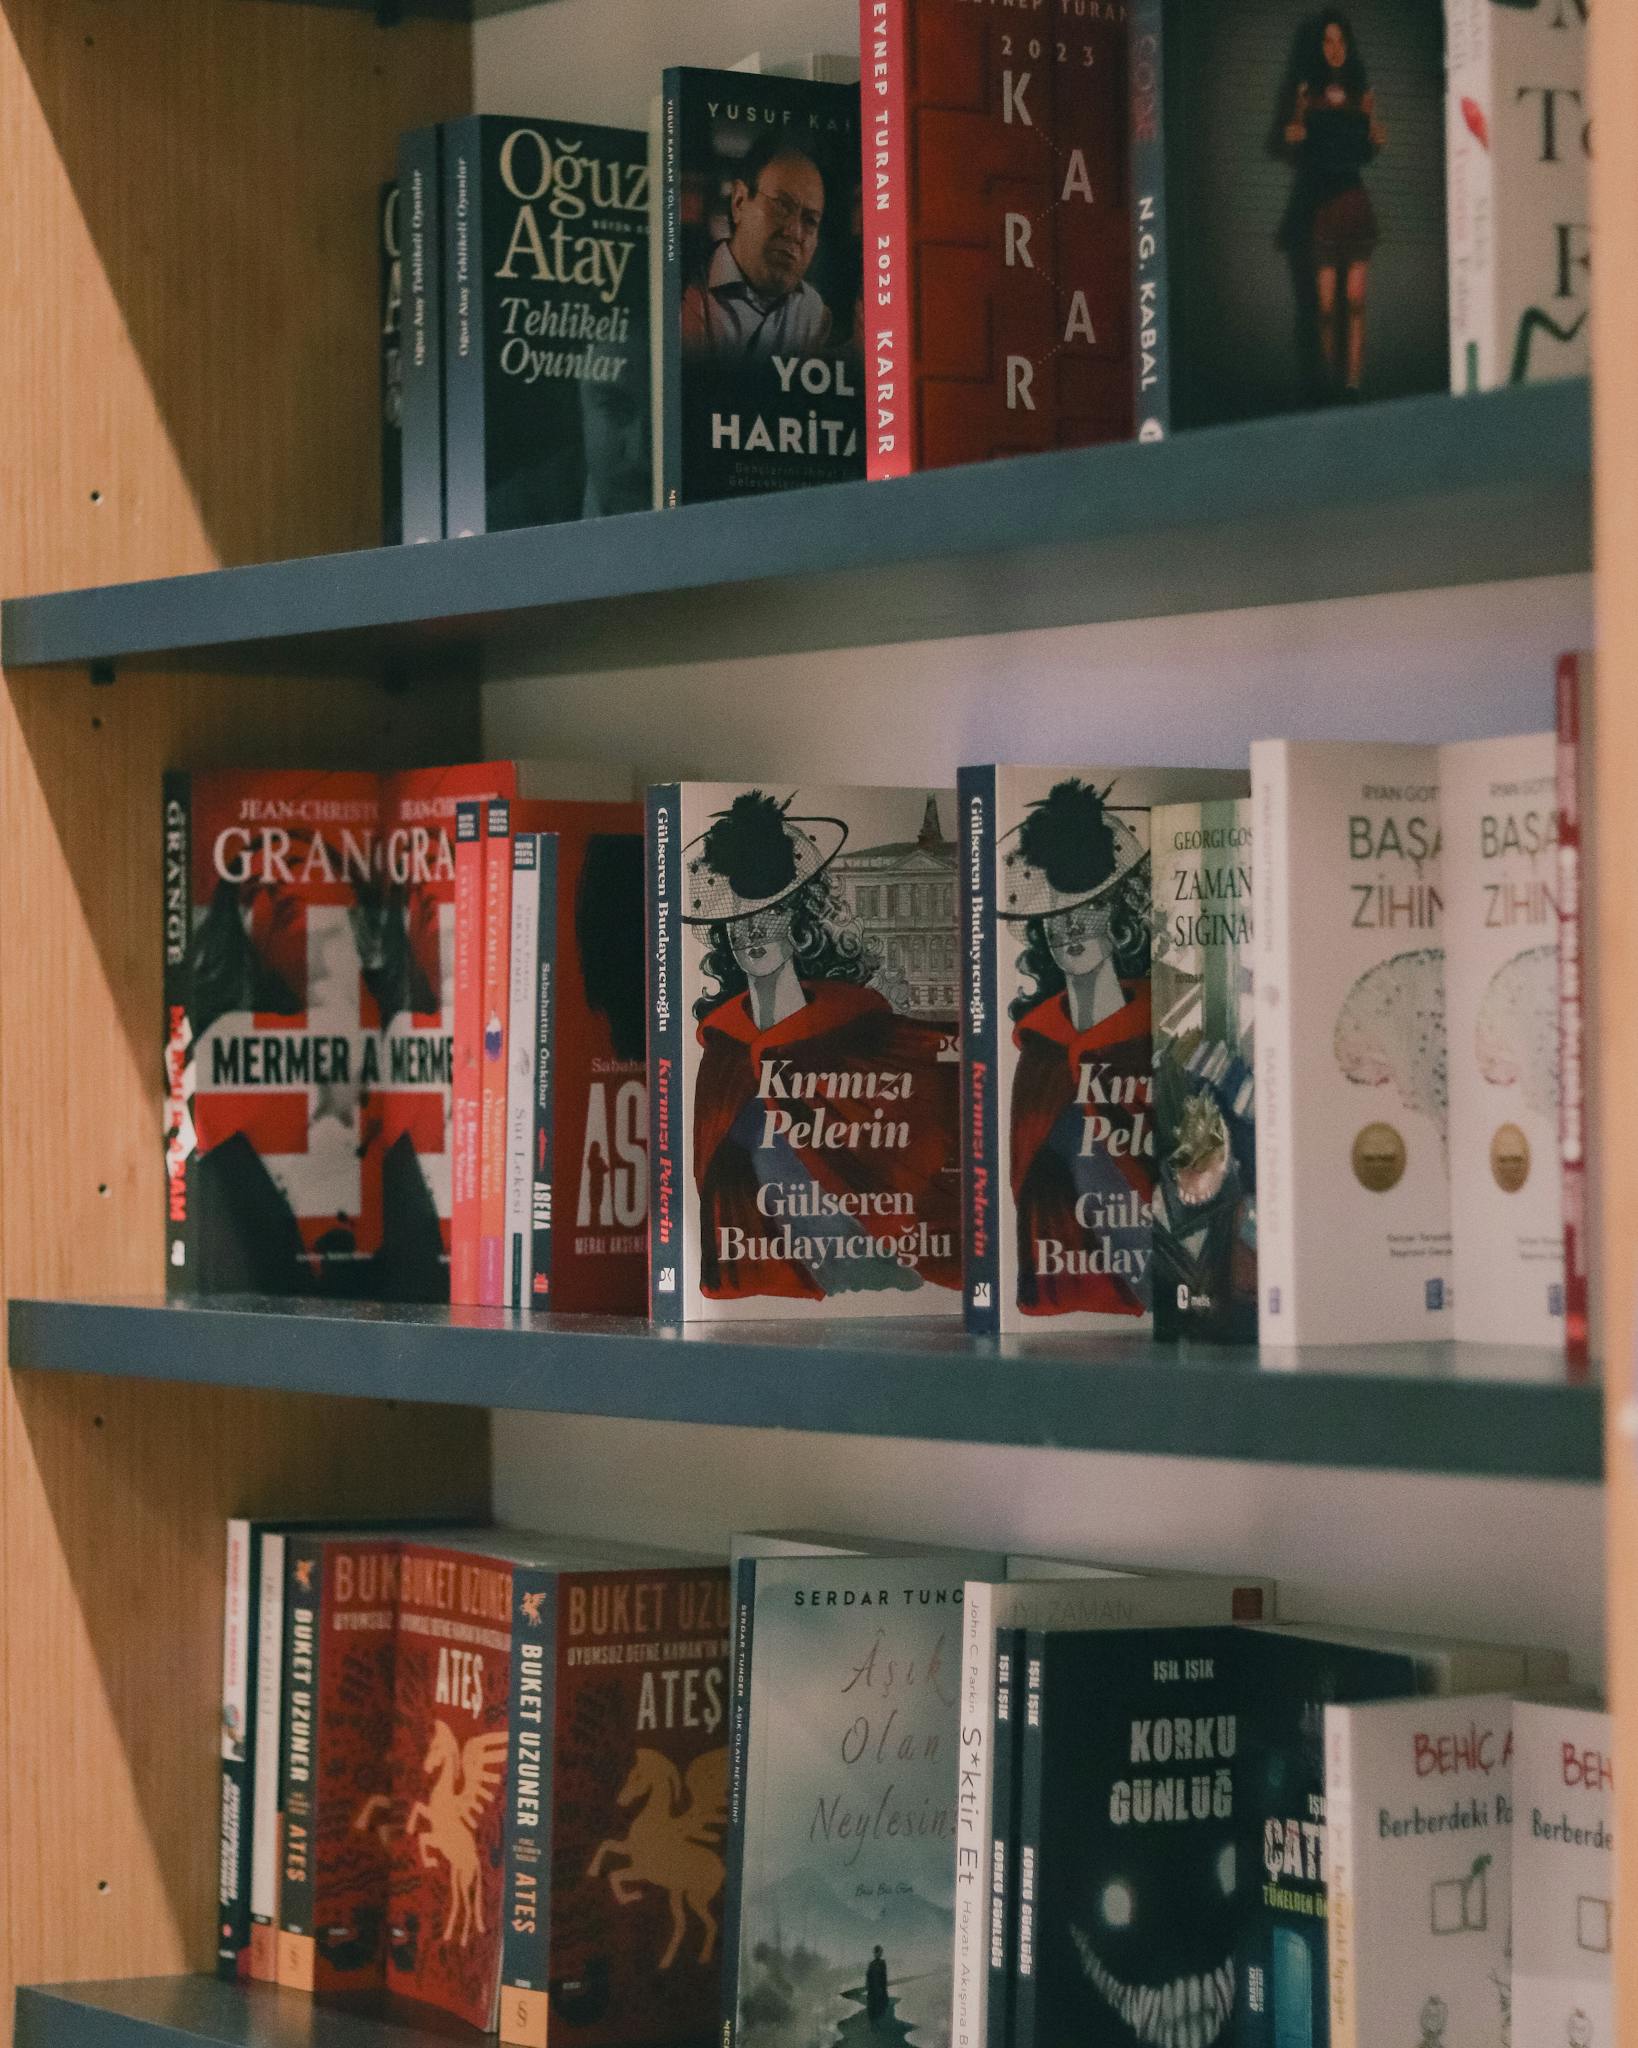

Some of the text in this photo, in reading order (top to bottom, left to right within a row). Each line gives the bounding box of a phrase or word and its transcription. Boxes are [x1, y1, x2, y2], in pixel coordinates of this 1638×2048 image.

[1001, 35, 1093, 66] 2023
[708, 102, 850, 131] YUSUF KA
[500, 129, 648, 220] Oğuz
[874, 110, 890, 211] TURAN
[667, 187, 675, 207] YOL
[495, 204, 636, 303] Atay
[877, 235, 891, 306] 2023
[501, 297, 630, 343] Tehlikeli
[1140, 282, 1158, 392] KABAL
[501, 339, 627, 385] Oyunlar
[771, 355, 855, 398] YOL
[876, 330, 895, 455] KARAR
[387, 826, 456, 885] GRA
[1173, 866, 1252, 902] ZAMAN
[655, 806, 670, 1032] Gülseren Budayıcıoğlu
[970, 796, 985, 1034] Gülseren Budayıcıoğlu
[538, 962, 551, 1041] Sabahattin
[212, 1036, 349, 1085] MERMER
[756, 1060, 913, 1100] Kırmızı
[658, 1057, 673, 1245] Kırmızı Pelerin
[759, 1107, 911, 1149] Pelerin
[533, 1181, 551, 1230] ASENA
[756, 1180, 915, 1217] Gülseren
[973, 1166, 988, 1257] Pelerin
[1075, 1192, 1152, 1229] Güls
[718, 1222, 951, 1269] Budayıcıoğlu
[569, 1582, 667, 1636] BUKET
[795, 1590, 888, 1606] SERDAR
[969, 1600, 979, 1638] John
[293, 1608, 314, 1685] BUKET
[739, 1604, 747, 1648] SERDAR
[436, 1647, 484, 1719] ATEŞ
[518, 1643, 544, 1724] BUKET
[968, 1666, 978, 1714] Parkin
[1153, 1658, 1214, 1683] IŞIL IŞIK
[636, 1667, 724, 1735] ATEŞ
[289, 1691, 312, 1782] UZUNER
[734, 1733, 742, 1762] OLAN
[841, 1709, 946, 1765] Olan
[1130, 1715, 1236, 1763] KORKU
[516, 1731, 542, 1827] UZUNER
[1109, 1768, 1233, 1825] GÜNLÜĞ
[1379, 1798, 1488, 1838] Berberdeki
[958, 1846, 978, 1885] Et
[957, 1900, 972, 2027] Hayatı Akışına
